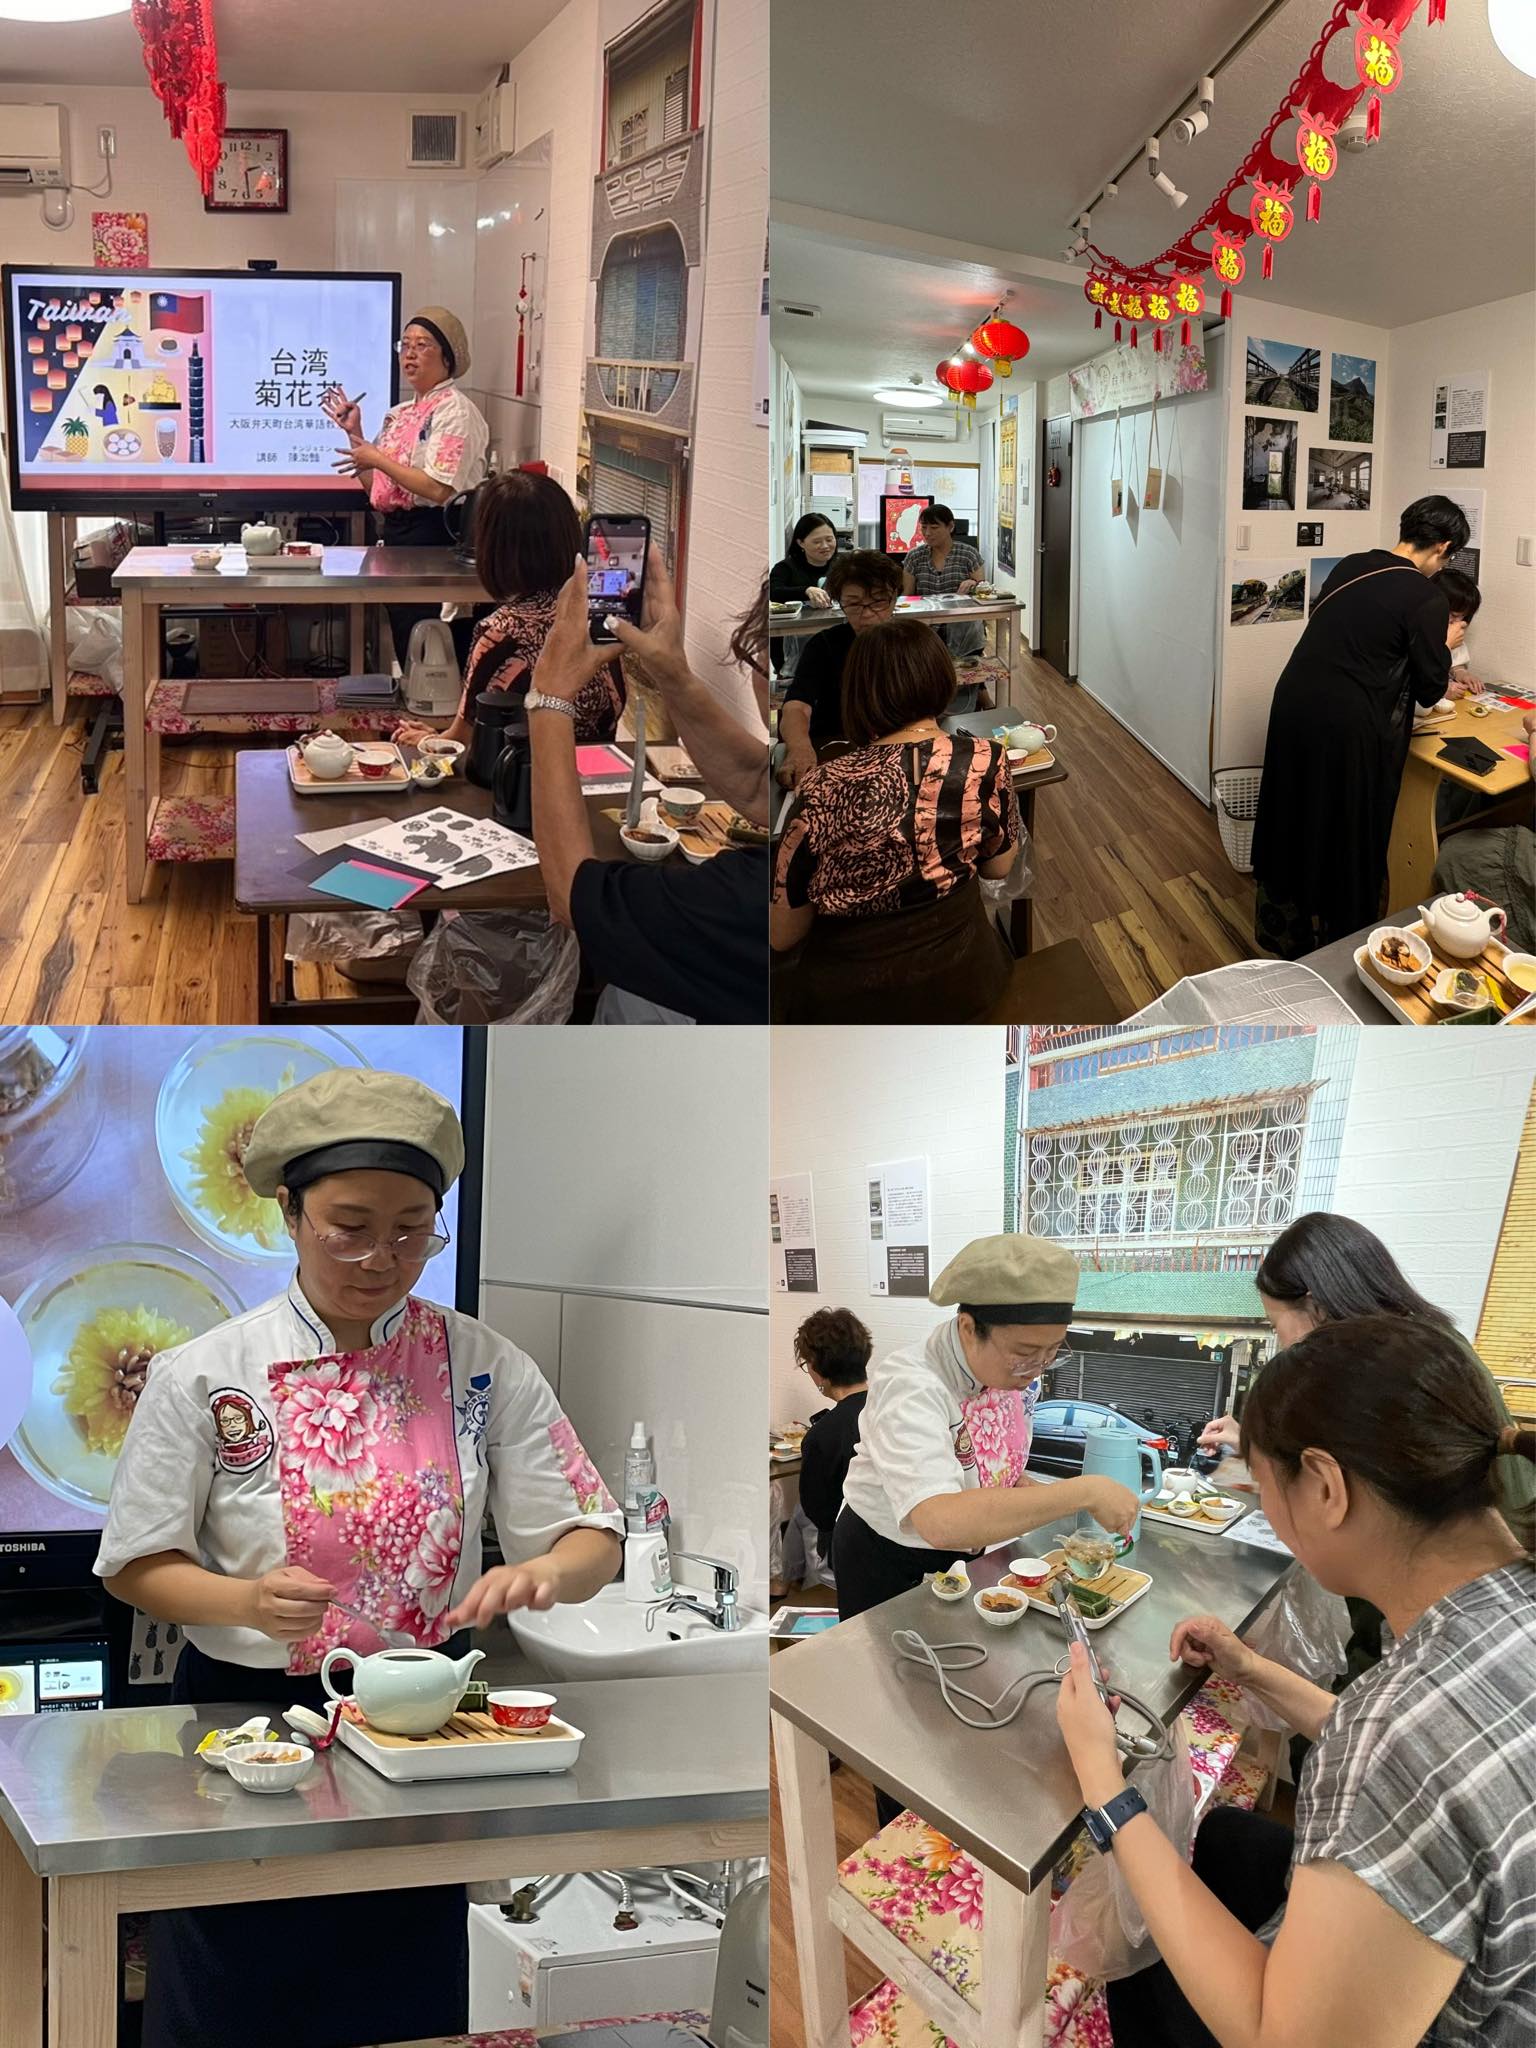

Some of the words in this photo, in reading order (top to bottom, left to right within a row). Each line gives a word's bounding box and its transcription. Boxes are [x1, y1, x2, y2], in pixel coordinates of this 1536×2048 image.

[1365, 35, 1394, 86] 福
[229, 143, 237, 152] 11
[240, 142, 252, 151] 12
[256, 143, 260, 152] 1
[1304, 129, 1330, 175] 福
[265, 152, 273, 161] 2
[219, 180, 227, 189] 8
[231, 189, 238, 198] 7
[242, 191, 250, 200] 6
[256, 189, 263, 199] 5
[1259, 198, 1285, 237] 福
[1218, 246, 1240, 280] 福
[1176, 283, 1199, 312] 福
[27, 298, 132, 323] Taiwan
[1148, 294, 1170, 320] 福
[271, 348, 328, 377] 台湾
